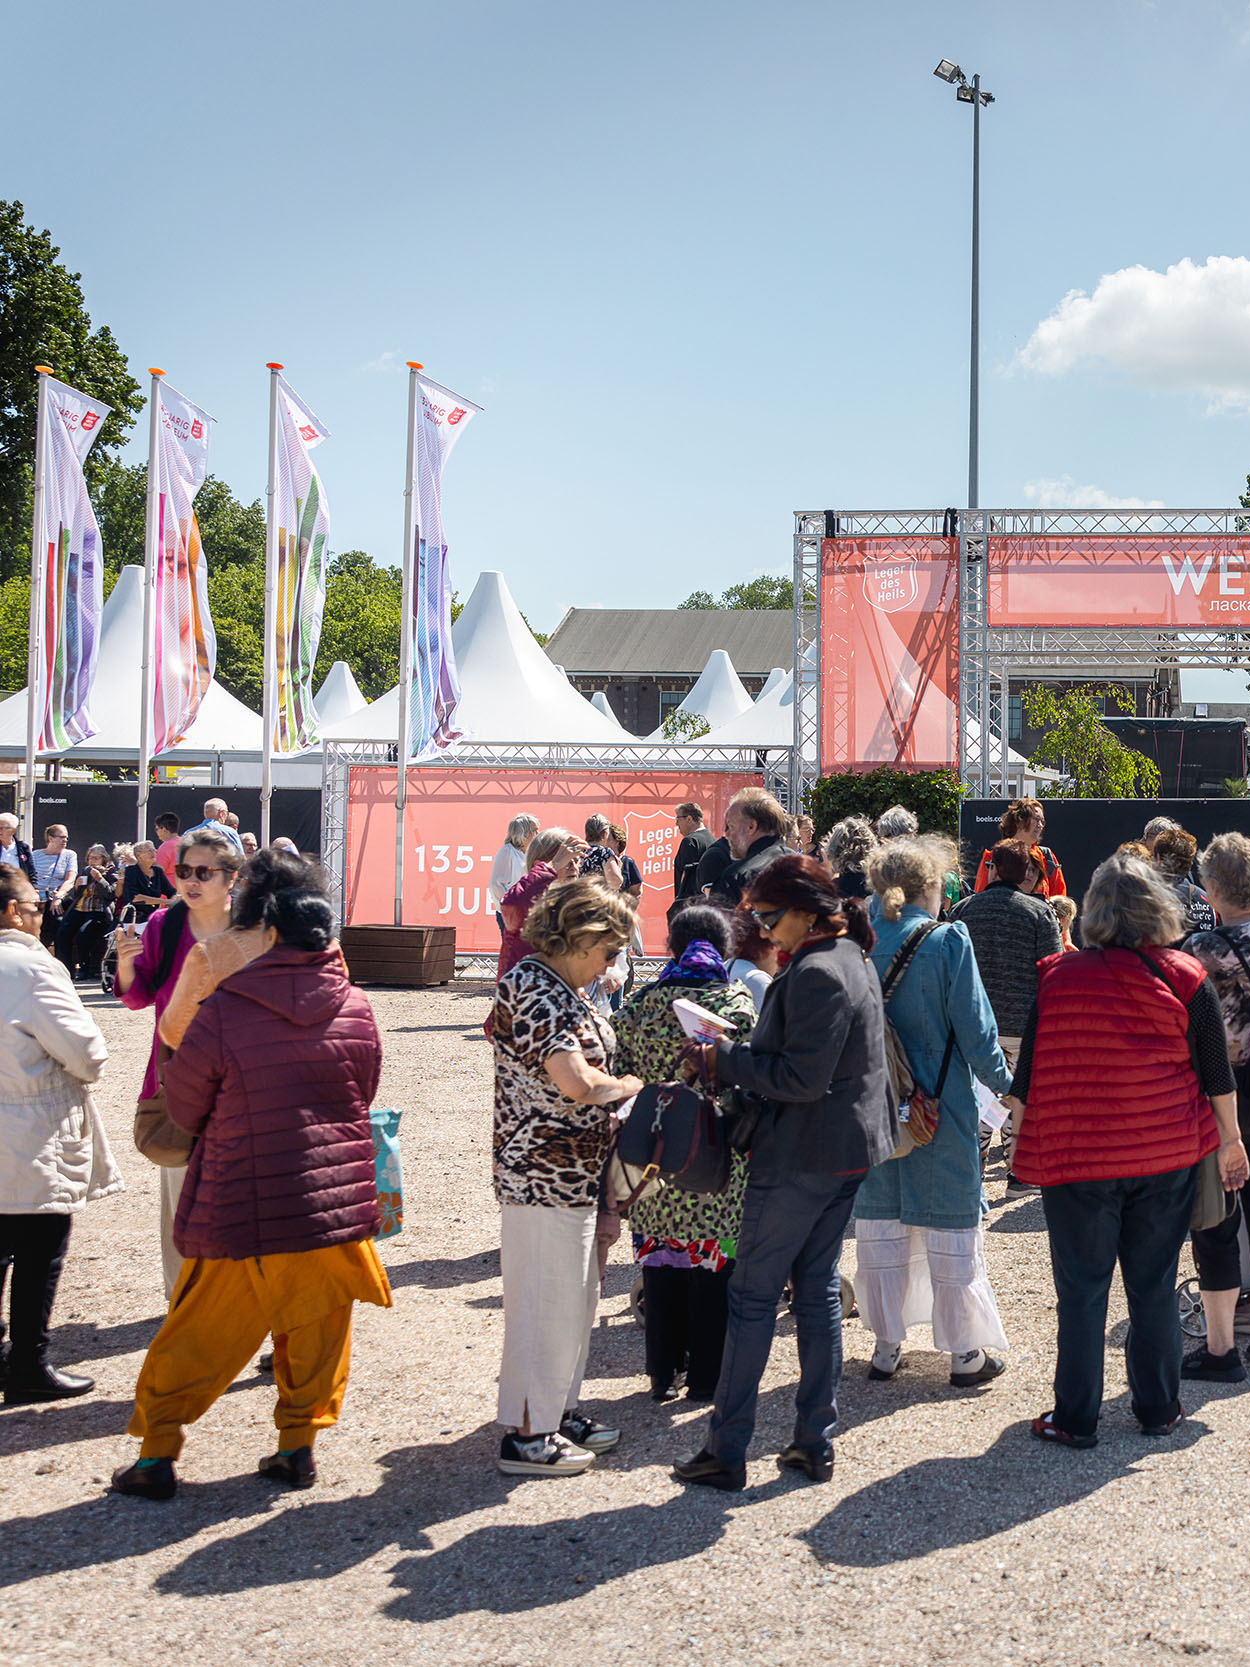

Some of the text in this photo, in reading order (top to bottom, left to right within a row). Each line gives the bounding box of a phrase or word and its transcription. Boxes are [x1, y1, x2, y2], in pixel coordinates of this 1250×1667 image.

[874, 565, 906, 579] Leger
[880, 578, 900, 590] des
[877, 588, 906, 603] Heils
[639, 826, 679, 844] Leger
[646, 843, 673, 859] des
